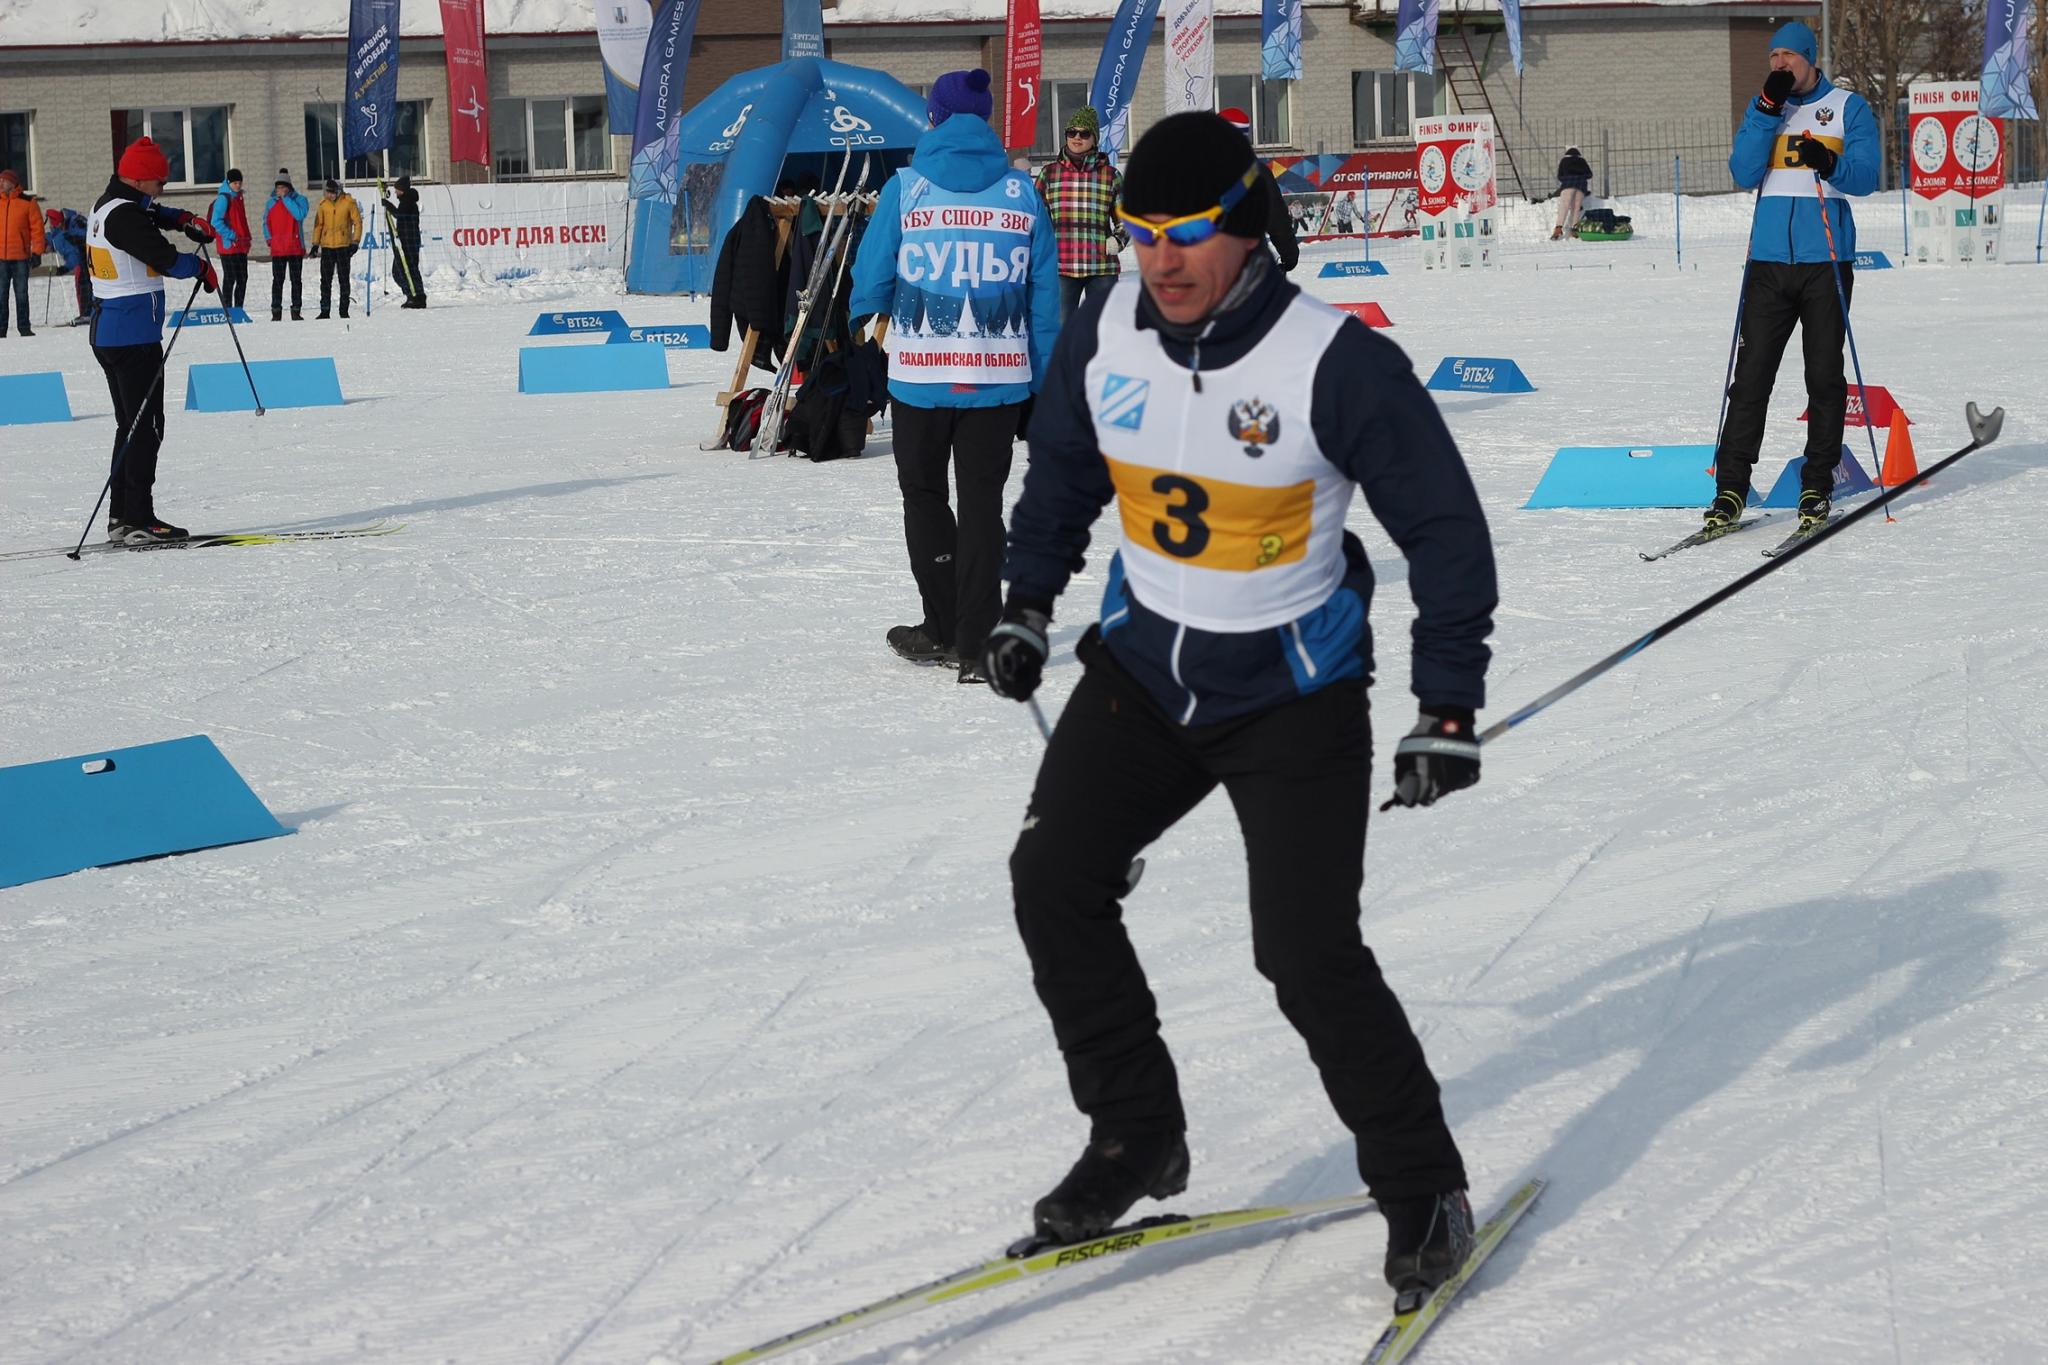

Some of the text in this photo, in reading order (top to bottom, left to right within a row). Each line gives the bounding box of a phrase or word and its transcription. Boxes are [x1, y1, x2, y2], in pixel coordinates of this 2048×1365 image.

[2005, 0, 2015, 32] AU
[357, 25, 388, 59] ГЛАВНОЕ
[362, 38, 391, 69] ПОБЕДА
[1105, 0, 1149, 119] AURORA GAMES
[656, 1, 685, 131] AURORA GAMES
[1913, 91, 1944, 104] FINISH
[1419, 123, 1443, 135] FINISH
[830, 134, 885, 146] odlo
[1784, 135, 1806, 167] 5
[1333, 173, 1346, 183] ОТ
[1347, 168, 1412, 182] СПОРТИВНОЙ
[1005, 178, 1021, 198] 8
[942, 209, 994, 227] СШОР
[452, 224, 607, 248] СПОРТ ДЛЯ ВСЕХ!
[897, 241, 1030, 288] СУДЬЯ
[1345, 265, 1371, 274] ВТБ24
[567, 316, 603, 329] ВТБ24
[647, 332, 689, 345] ВТБ24
[899, 351, 1027, 367] САХАЛИНСКАЯ ОБЛАСТЬ
[1462, 366, 1496, 383] ВТБ24
[1152, 474, 1210, 558] 3
[129, 543, 188, 552] FISCHER
[1257, 533, 1284, 566] 3
[1055, 1232, 1145, 1267] FISCHER
